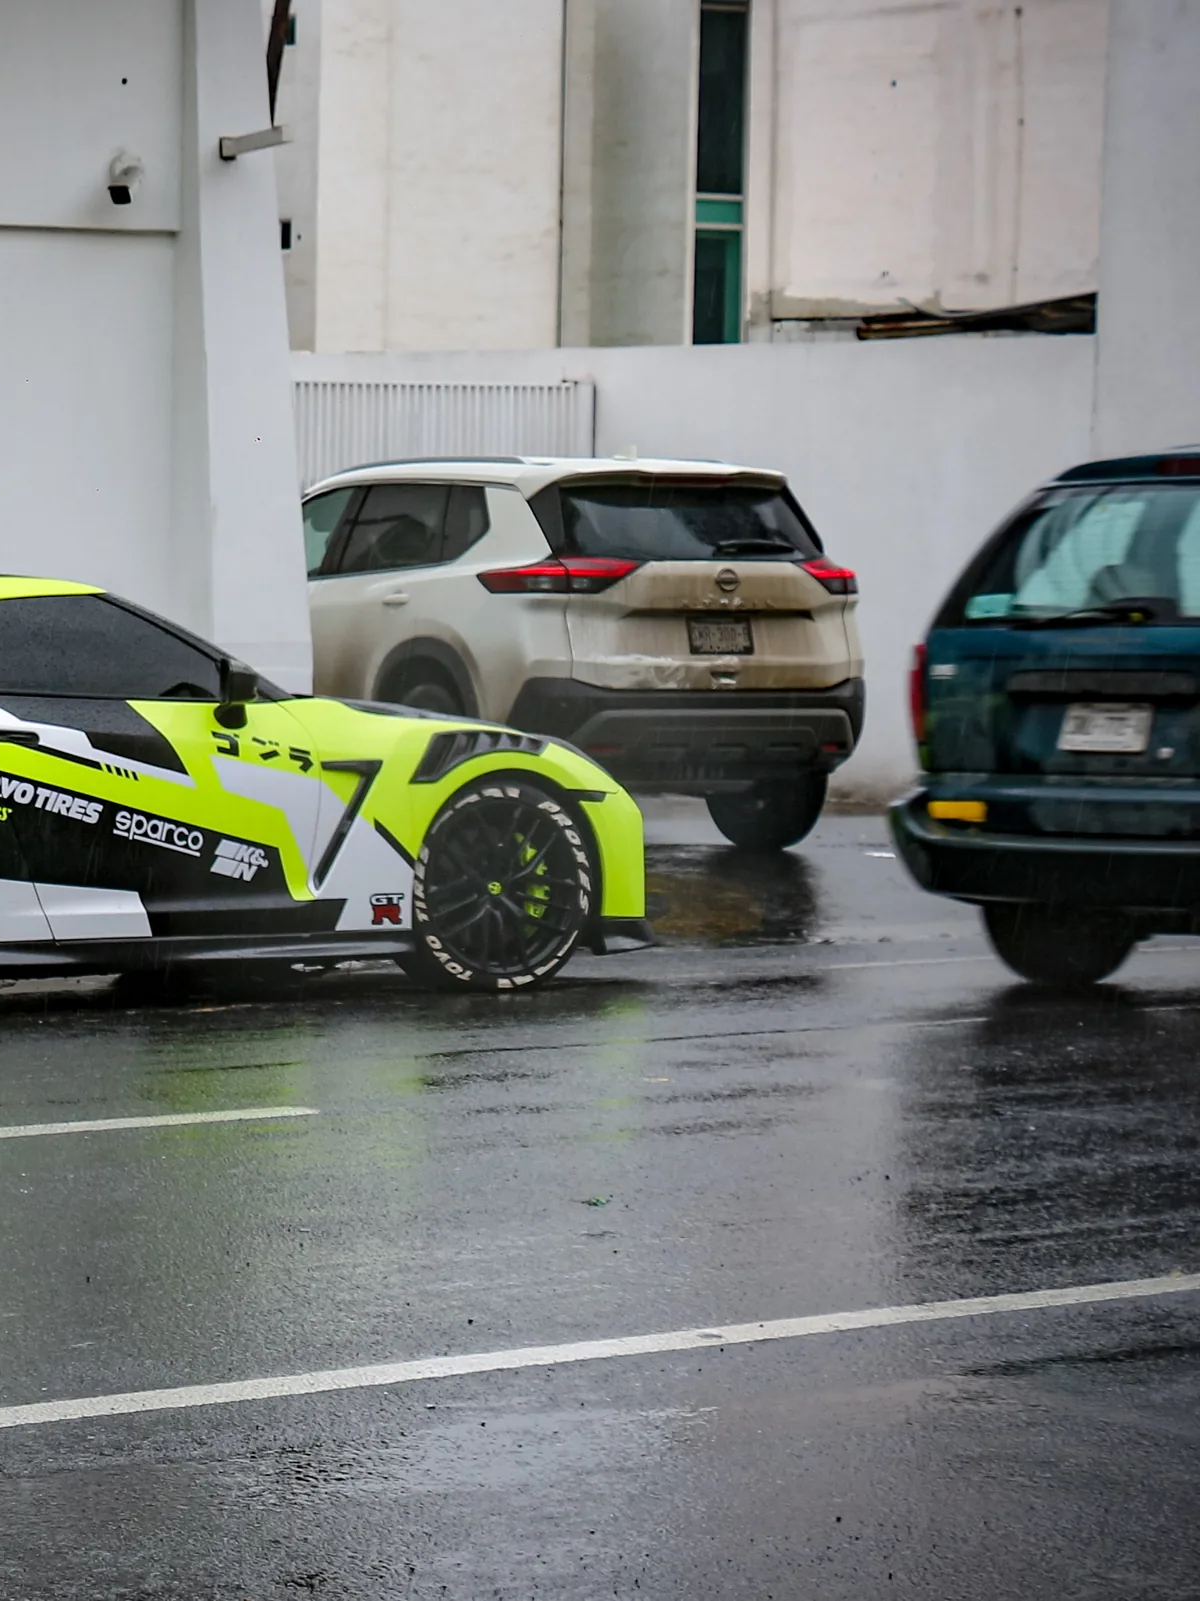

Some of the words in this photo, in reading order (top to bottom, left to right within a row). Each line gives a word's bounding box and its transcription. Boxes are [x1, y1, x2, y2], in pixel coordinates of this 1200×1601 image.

[115, 811, 204, 851] sparco
[537, 801, 592, 916] PROXES
[425, 935, 473, 980] TOYO
